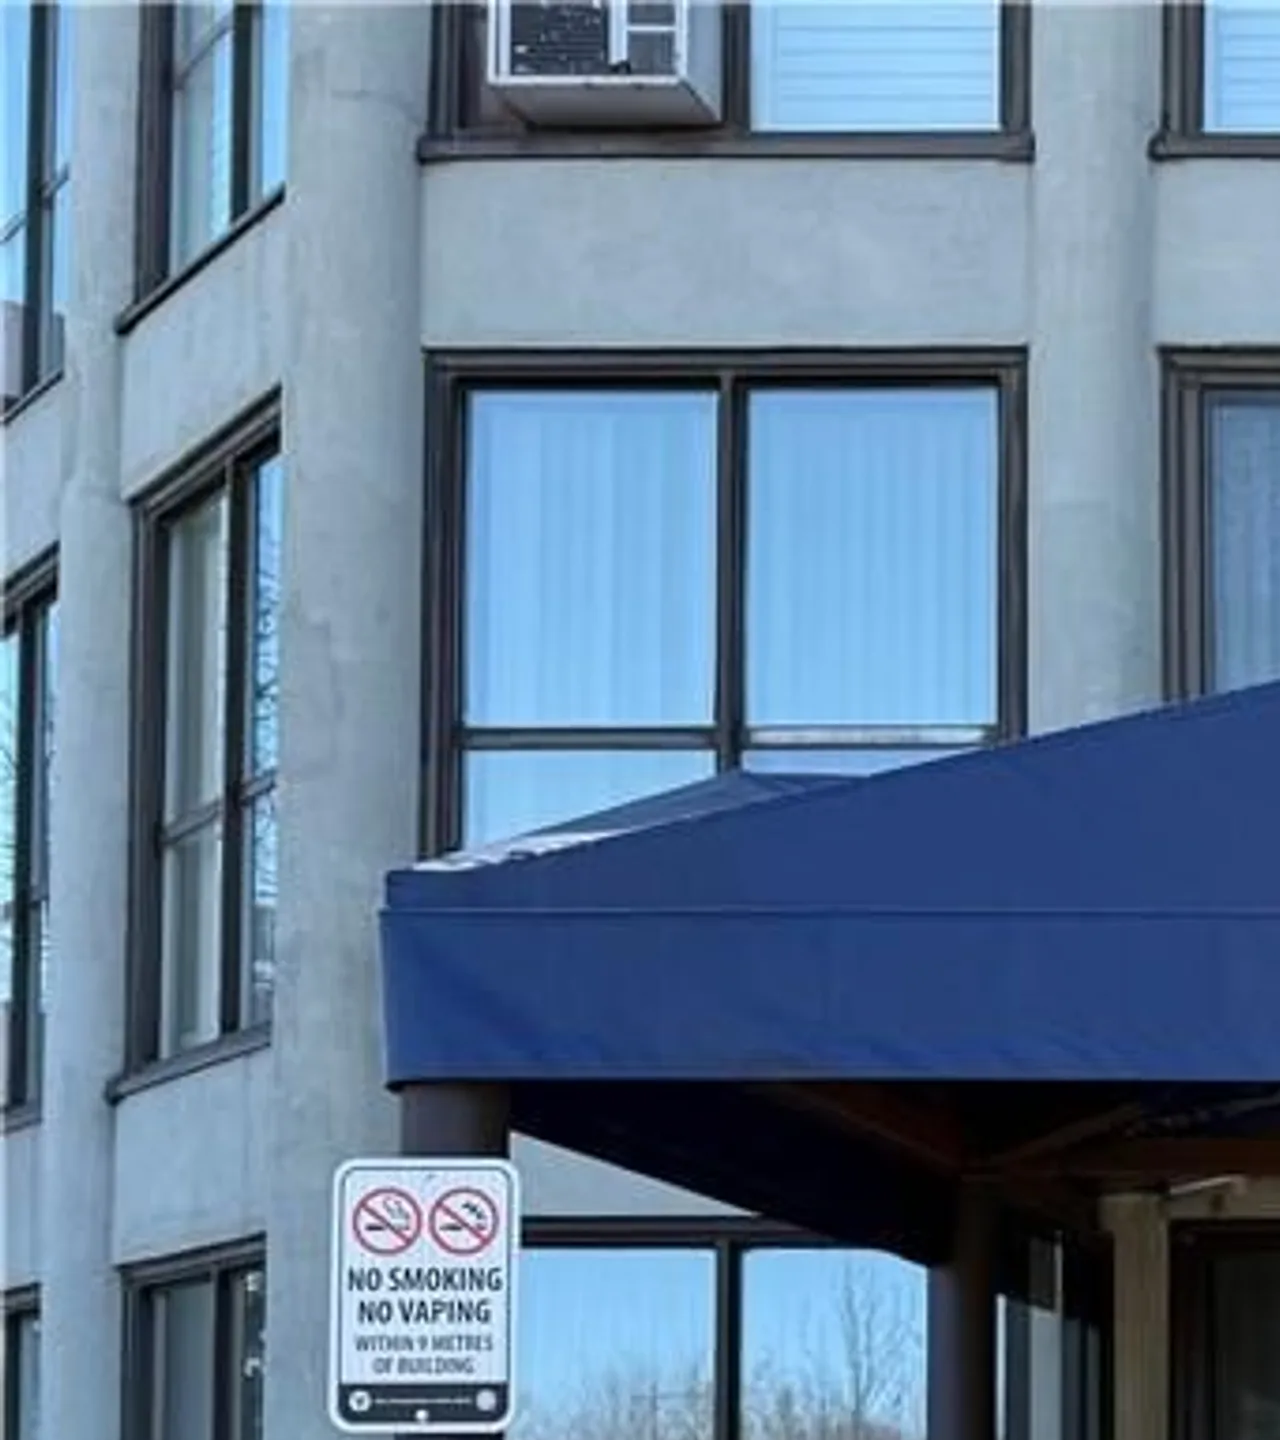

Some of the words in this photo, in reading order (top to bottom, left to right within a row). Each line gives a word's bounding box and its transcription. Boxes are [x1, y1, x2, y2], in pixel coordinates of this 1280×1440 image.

[348, 1267, 383, 1292] NO
[388, 1267, 503, 1292] SMOKING
[358, 1300, 393, 1325] NO
[398, 1300, 492, 1325] VAPING
[355, 1335, 414, 1352] WITHIN
[418, 1335, 428, 1352] 9
[431, 1335, 493, 1352] METRES
[372, 1357, 394, 1374] OF
[397, 1357, 475, 1375] BUILDING
